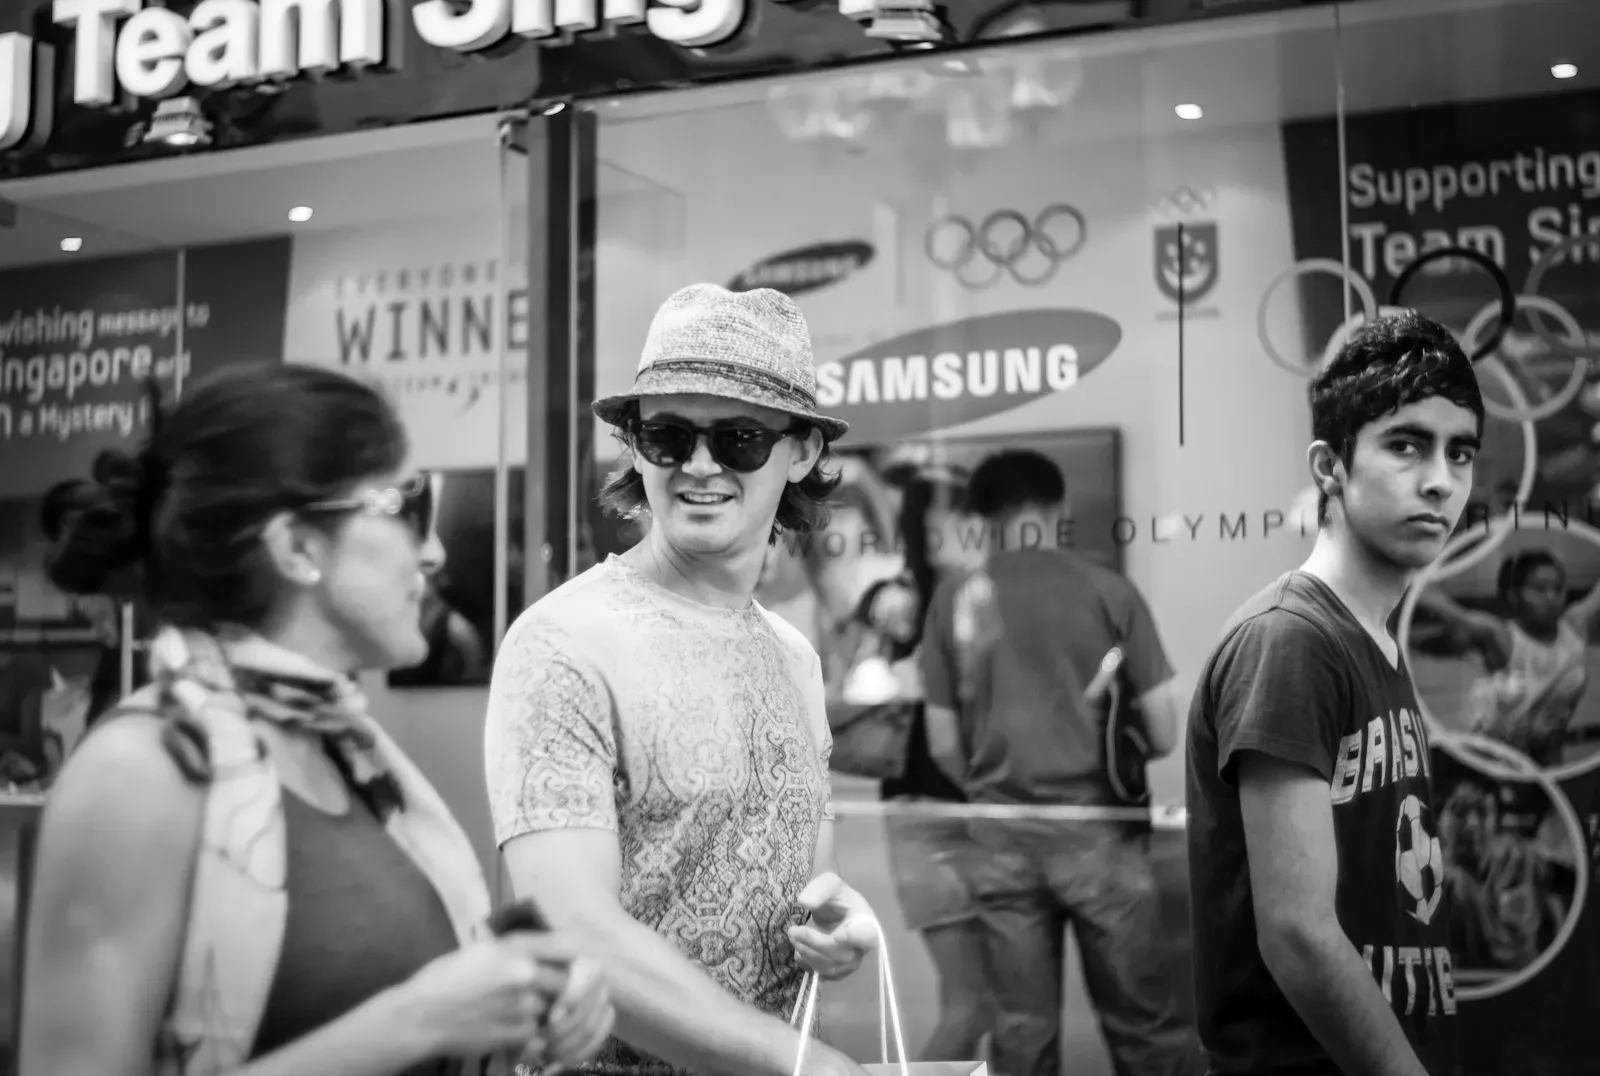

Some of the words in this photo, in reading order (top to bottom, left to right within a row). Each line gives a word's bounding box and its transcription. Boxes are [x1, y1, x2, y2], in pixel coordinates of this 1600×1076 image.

[52, 0, 385, 105] Team
[1349, 147, 1600, 215] Supporting
[1349, 221, 1506, 281] Team
[815, 343, 1080, 408] SAMSUNG
[782, 517, 1077, 559] WORDWIDE
[1330, 707, 1430, 806] BRASI
